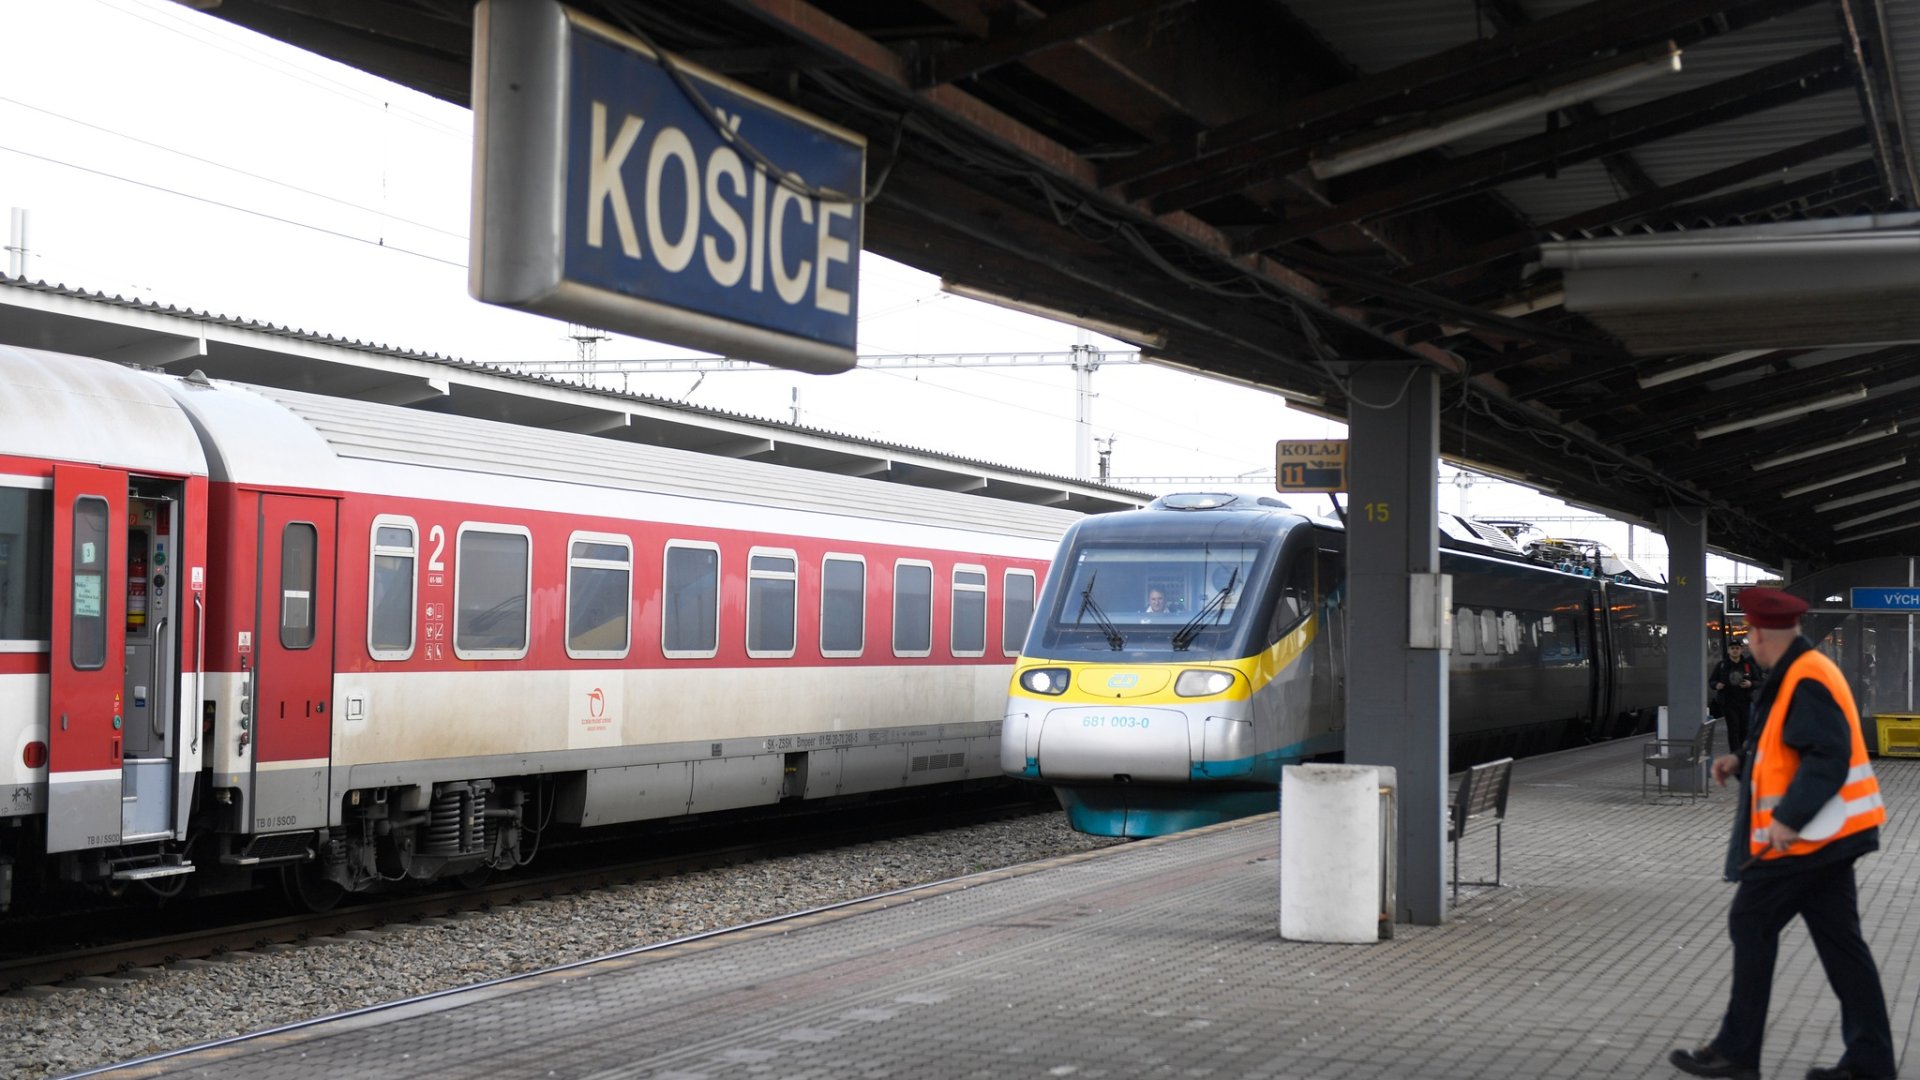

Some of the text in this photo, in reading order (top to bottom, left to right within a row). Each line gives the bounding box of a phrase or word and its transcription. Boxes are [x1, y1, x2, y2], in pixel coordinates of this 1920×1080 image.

[587, 102, 854, 316] KOŠICE
[1283, 466, 1305, 485] 11
[1364, 503, 1390, 522] 15
[428, 525, 444, 571] 2
[1884, 592, 1920, 605] VÝCH
[1082, 715, 1150, 729] 681 003-0
